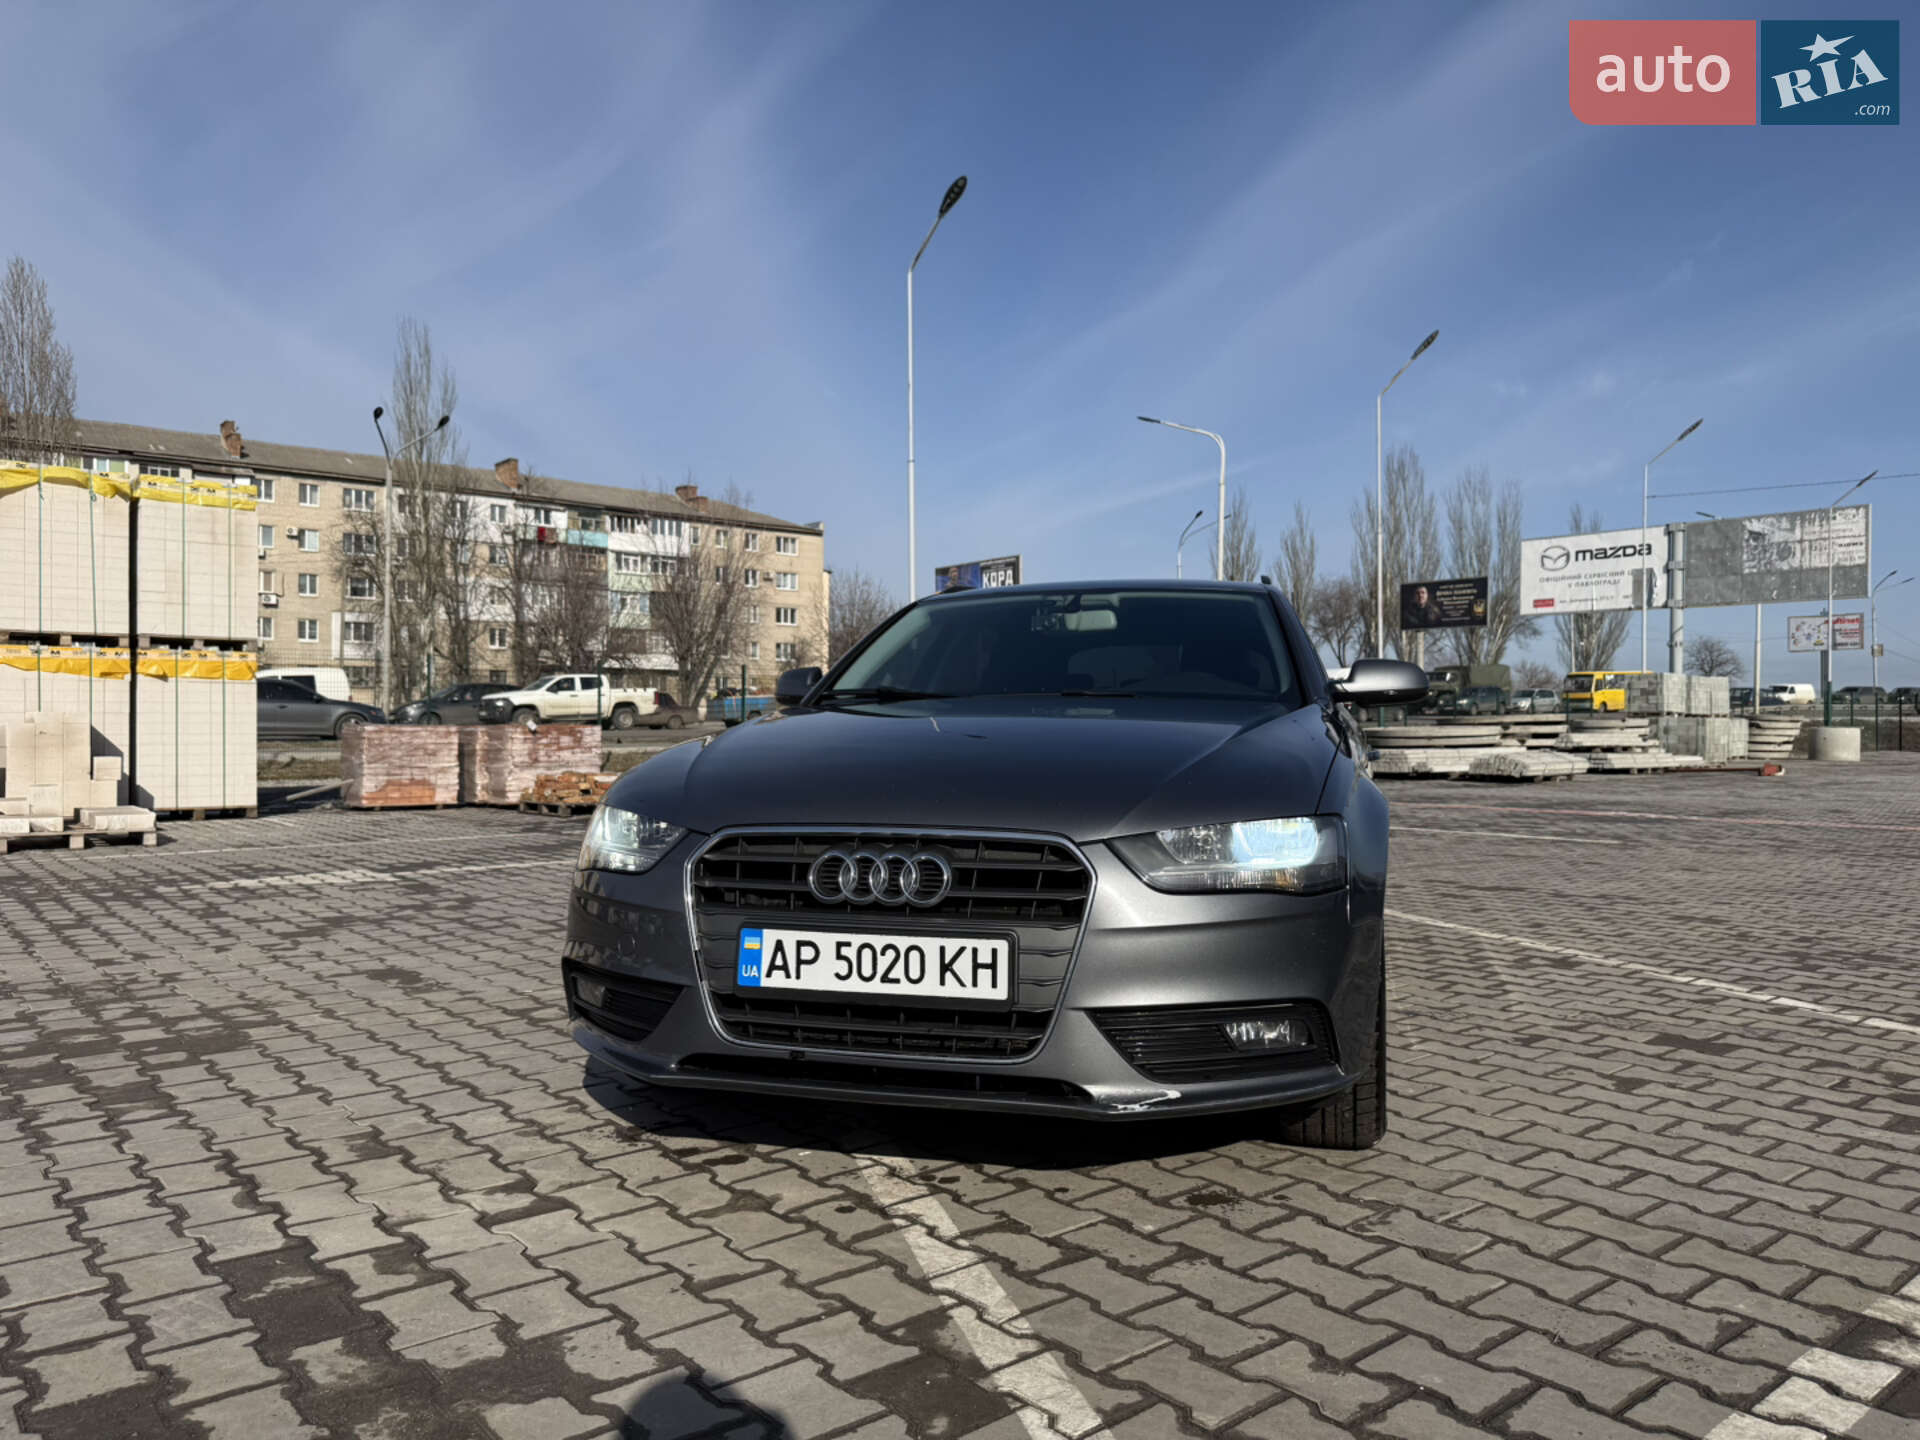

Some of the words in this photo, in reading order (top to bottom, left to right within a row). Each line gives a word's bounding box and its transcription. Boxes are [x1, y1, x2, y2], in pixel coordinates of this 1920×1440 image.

[742, 964, 759, 977] UA
[765, 939, 820, 980] AP
[834, 941, 926, 985] 5020
[939, 945, 998, 989] KH
